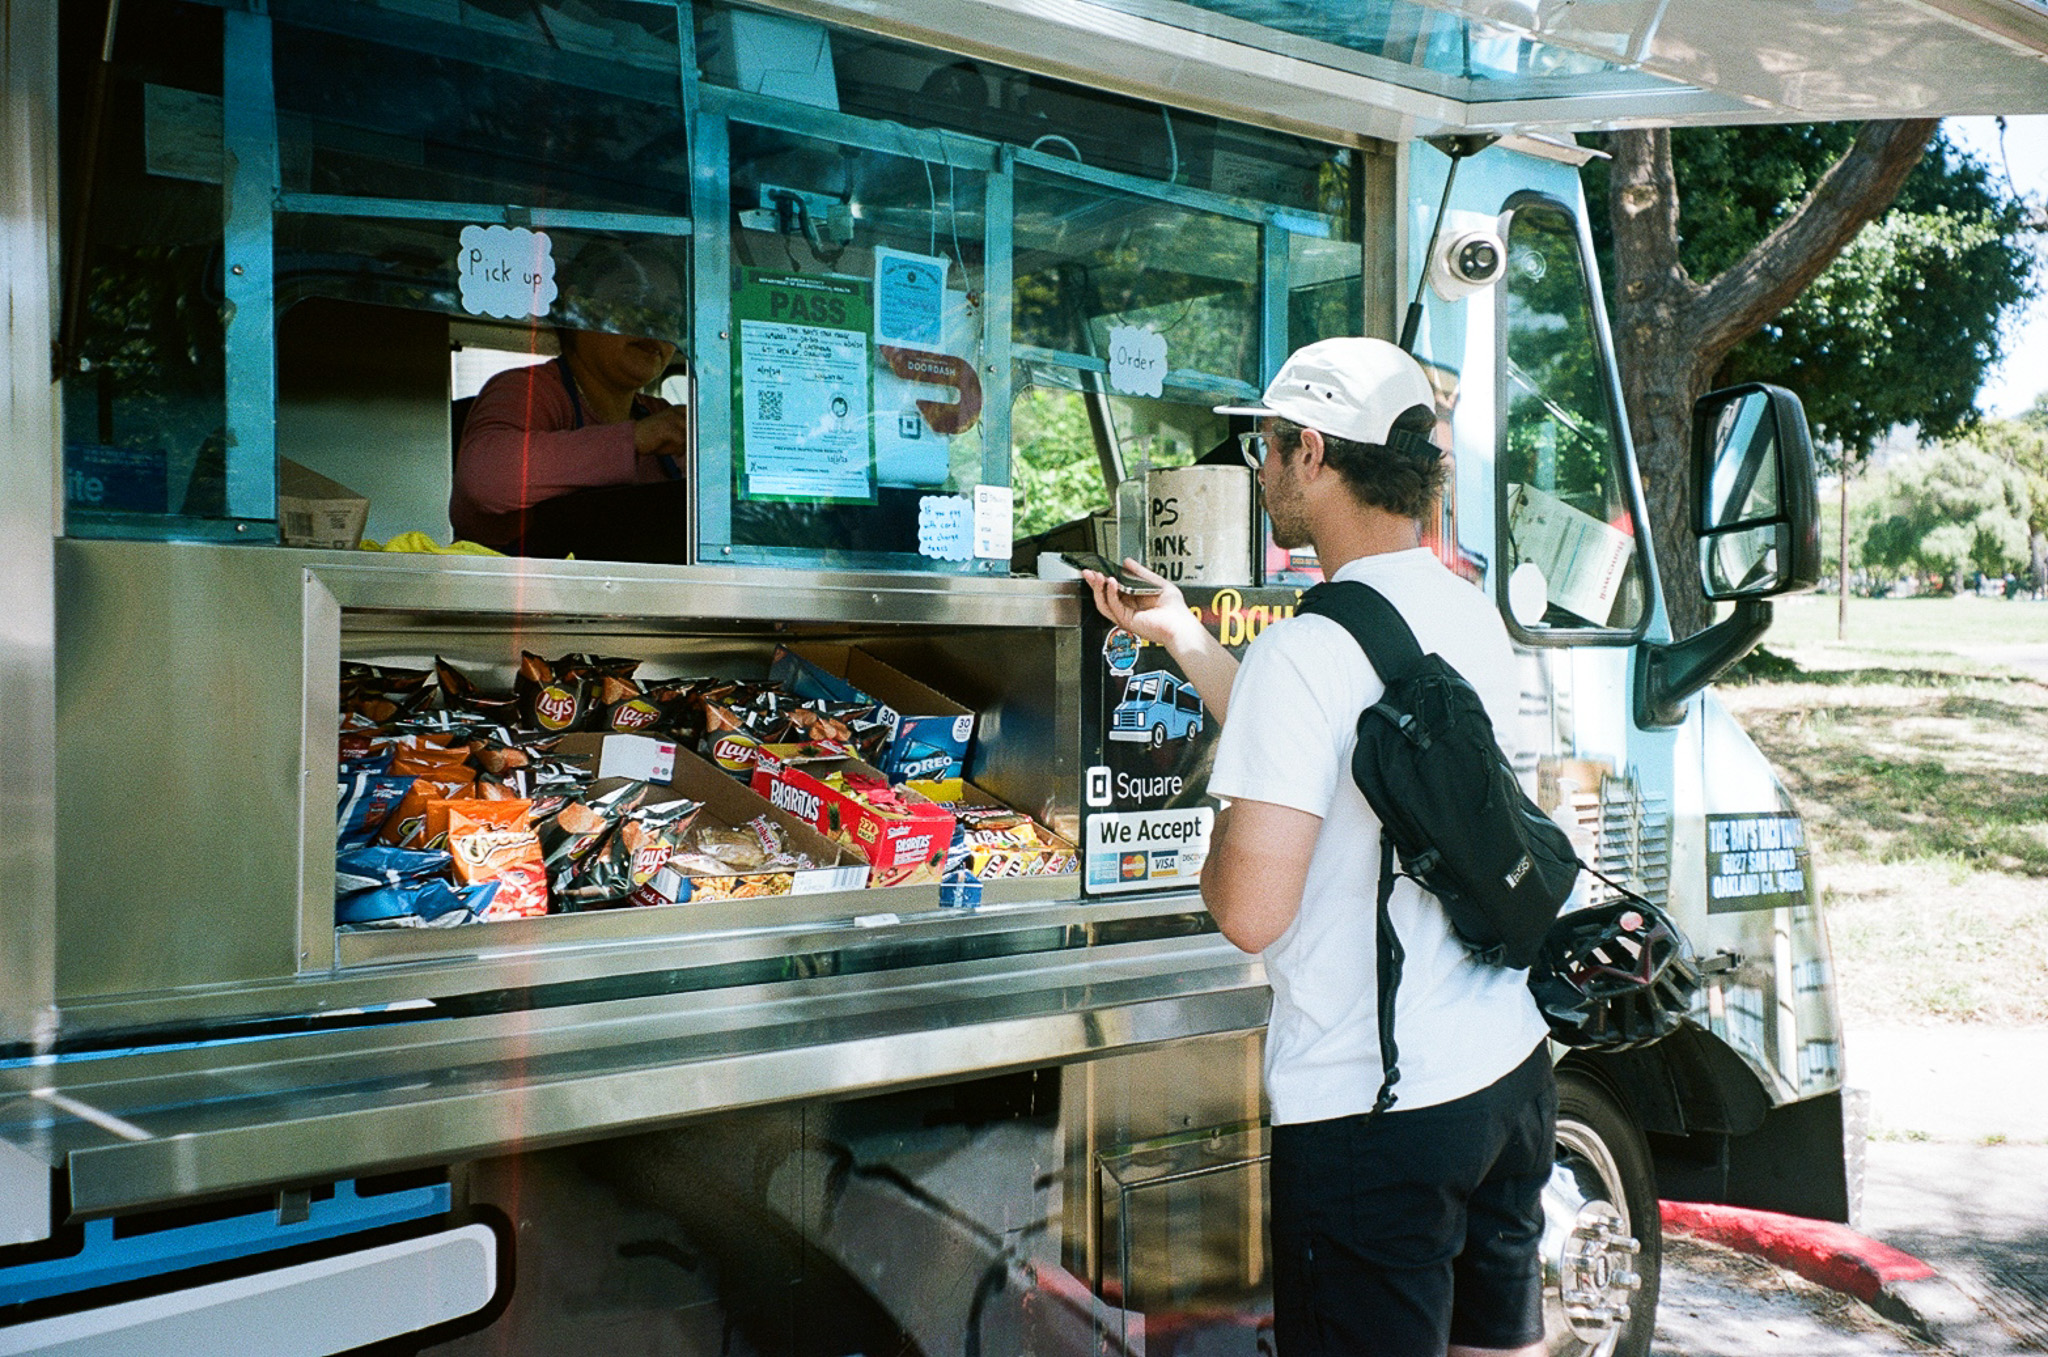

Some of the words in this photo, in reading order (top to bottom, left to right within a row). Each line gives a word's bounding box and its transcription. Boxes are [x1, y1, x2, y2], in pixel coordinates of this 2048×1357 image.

[470, 248, 511, 283] Pick
[523, 272, 542, 293] up
[770, 291, 846, 324] PASS
[907, 361, 956, 376] DOORDASH
[1117, 345, 1155, 370] Order
[1151, 497, 1178, 528] PS
[937, 532, 959, 543] charge
[1153, 534, 1191, 556] ANK
[881, 709, 896, 725] 30
[958, 718, 971, 729] 30
[904, 756, 953, 778] OREO
[1117, 772, 1183, 804] Square
[1101, 821, 1131, 844] We
[1137, 816, 1201, 844] Accept
[1708, 820, 1729, 853] THE
[1154, 858, 1175, 869] VISA
[1747, 850, 1769, 873] SAN
[1712, 874, 1760, 899] OAKLAND
